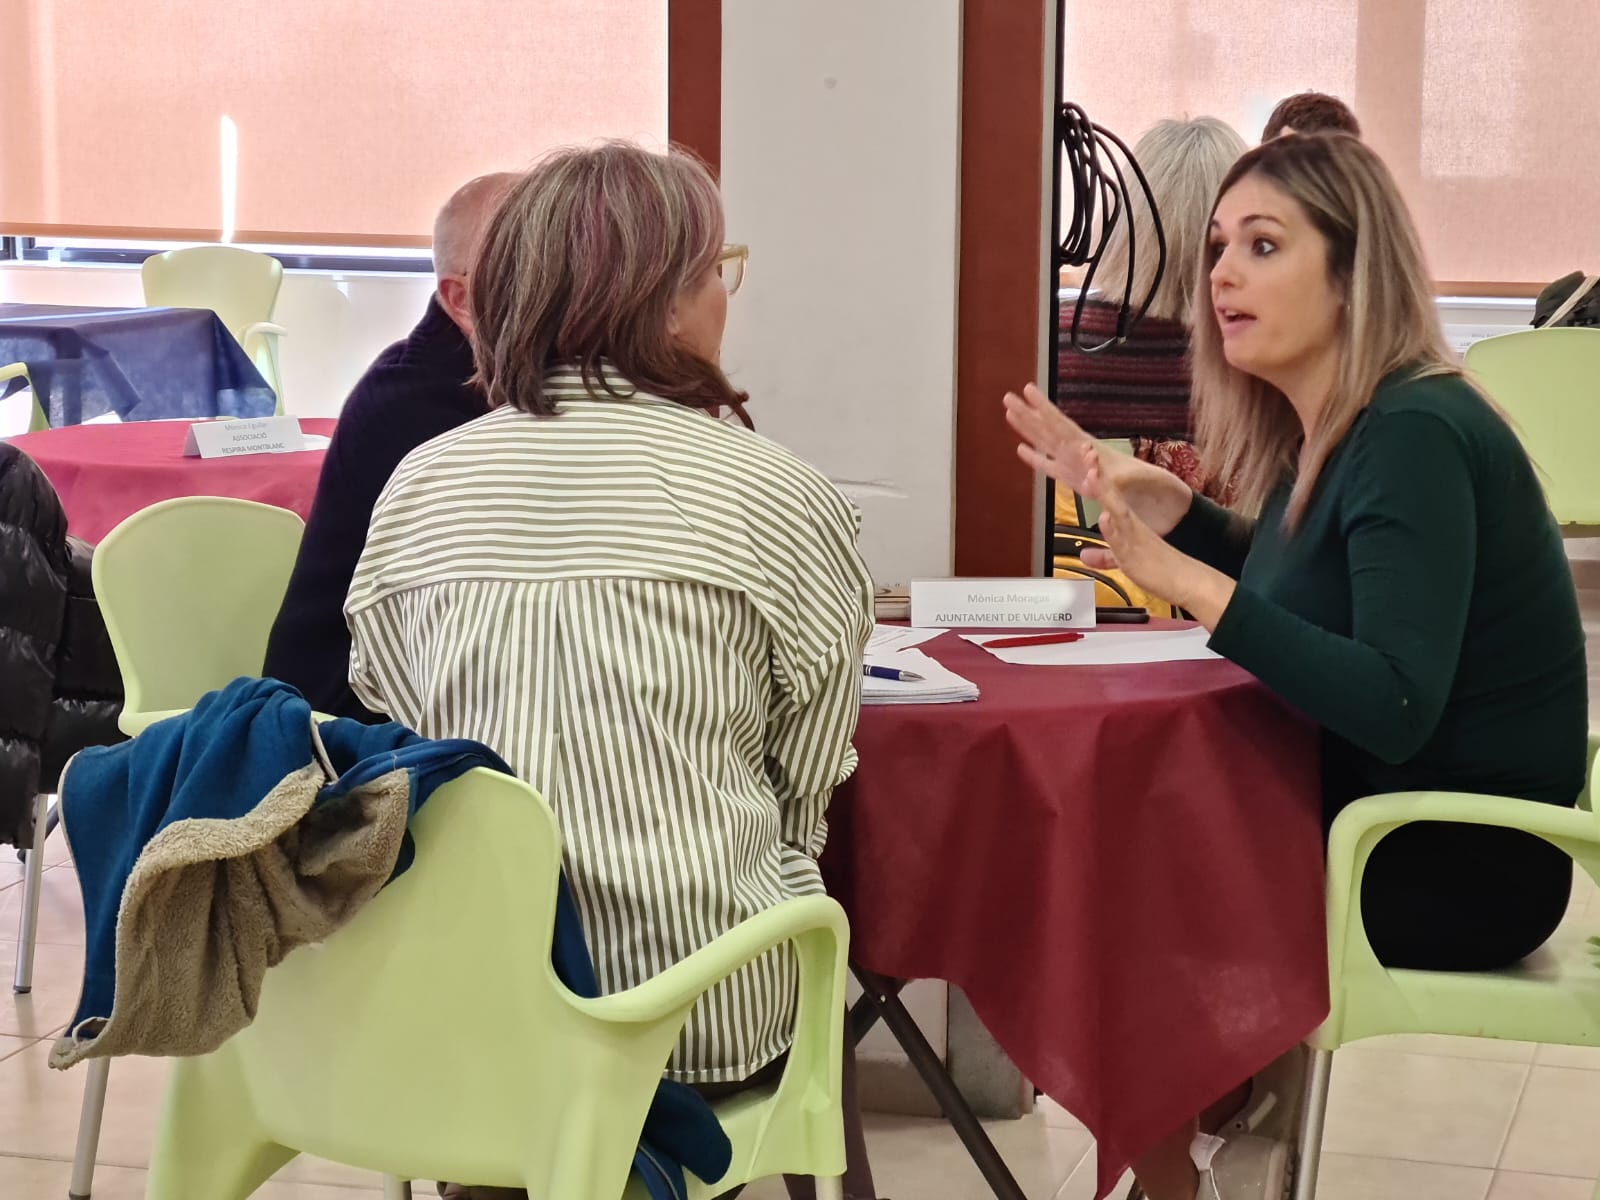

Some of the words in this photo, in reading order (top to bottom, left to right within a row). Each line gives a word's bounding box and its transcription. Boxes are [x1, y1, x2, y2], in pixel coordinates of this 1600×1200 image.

[222, 446, 246, 454] RESPIRA
[246, 443, 285, 451] MONTBLANC
[967, 592, 1004, 603] Mònica
[935, 612, 1004, 623] AJUNTAMENT
[1007, 612, 1021, 622] DE
[1022, 612, 1072, 622] VILAVERD
